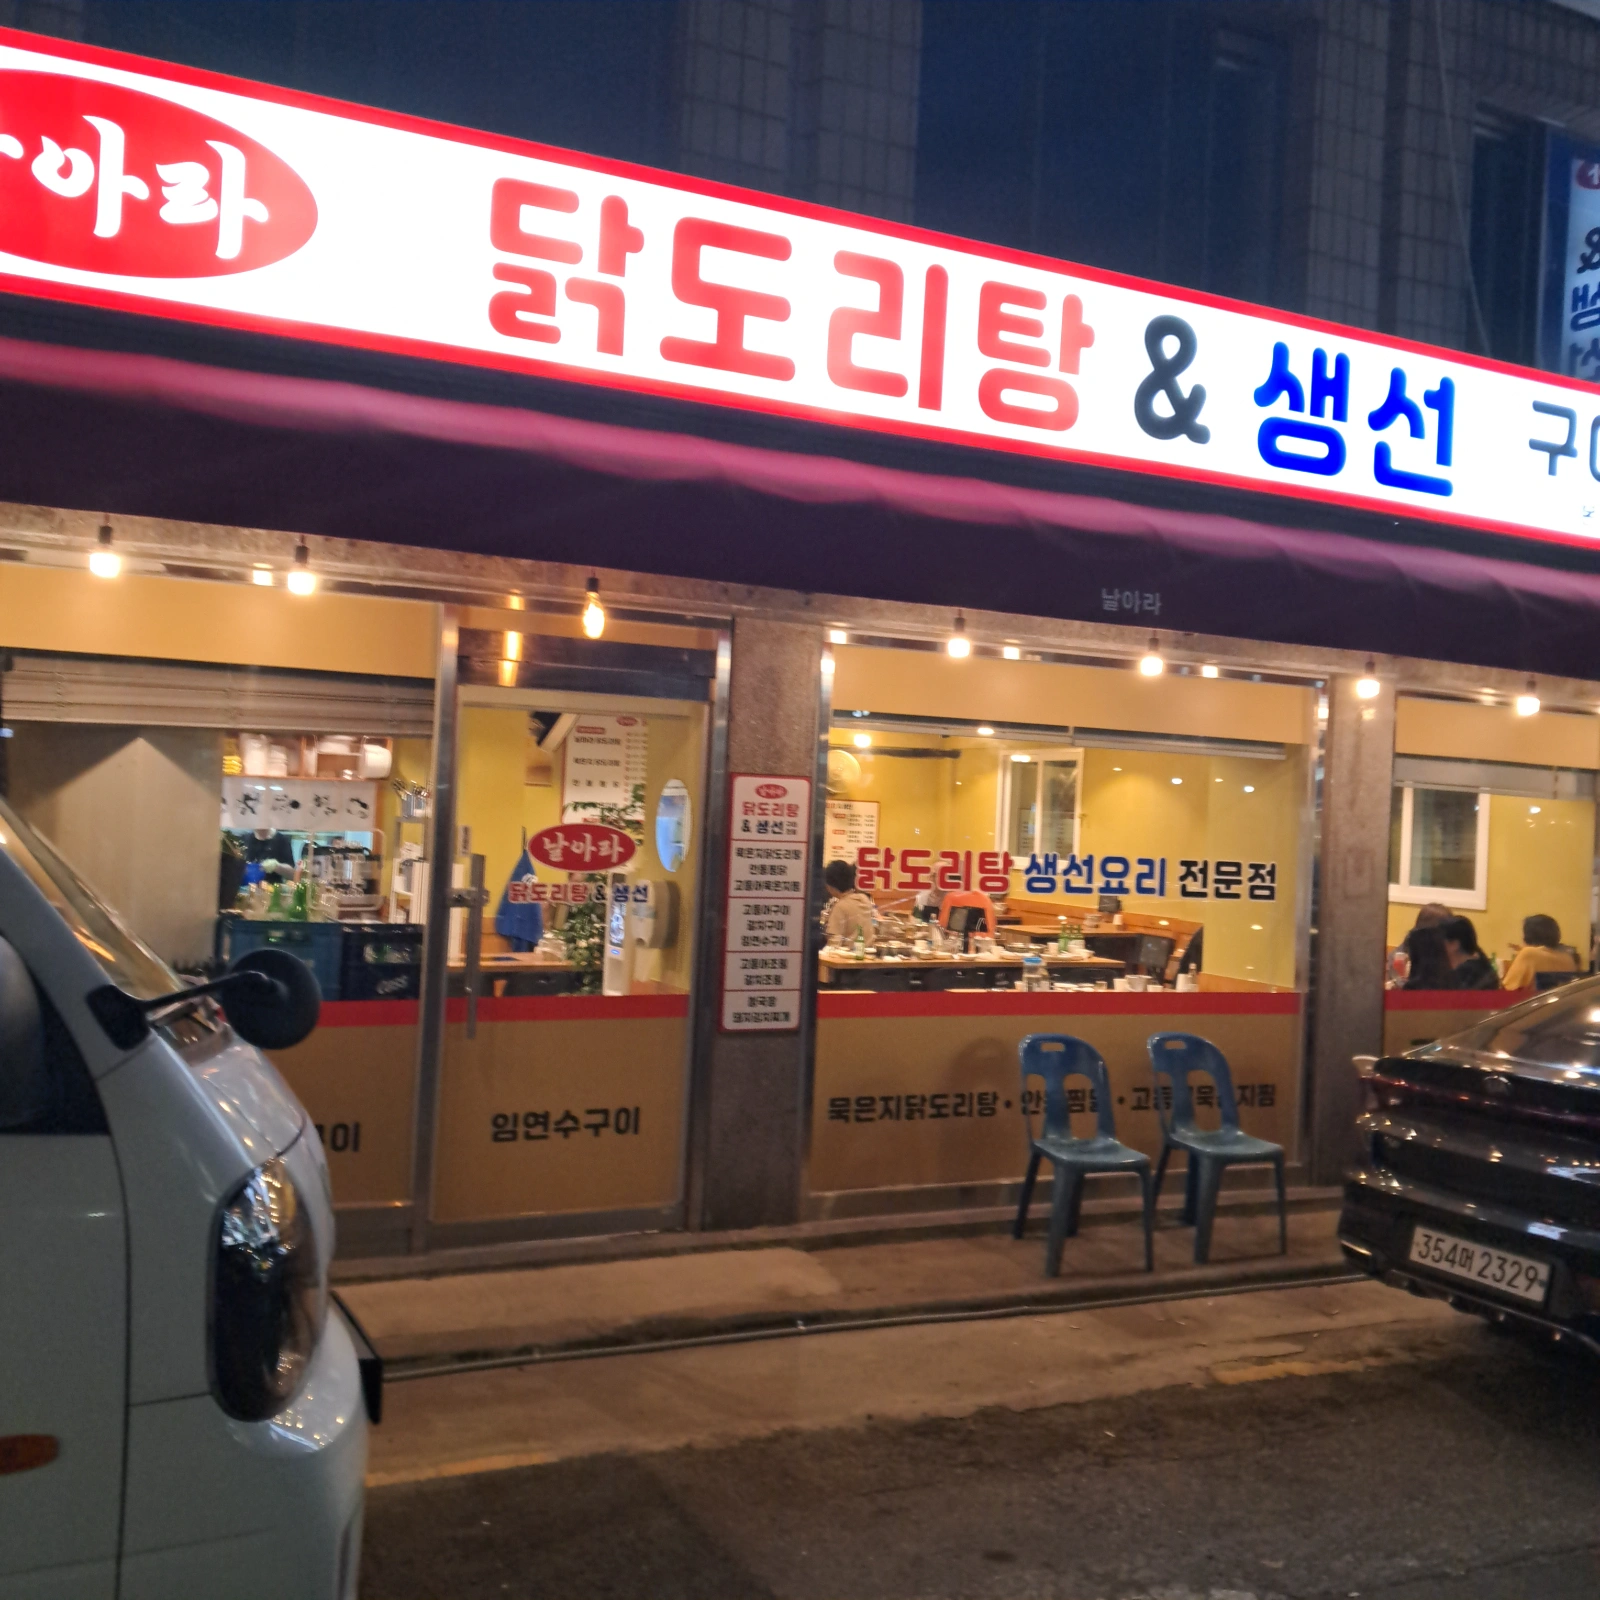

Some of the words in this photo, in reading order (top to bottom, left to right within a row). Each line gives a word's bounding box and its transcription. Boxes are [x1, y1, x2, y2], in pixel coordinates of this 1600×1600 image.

[0, 114, 270, 261] 아라
[487, 176, 1096, 432] 닭도리탕
[1134, 314, 1212, 444] &
[1253, 341, 1456, 497] 생선
[1100, 587, 1163, 616] 날아라
[742, 801, 800, 818] 닭도리탕
[756, 819, 784, 835] 생선
[541, 831, 625, 864] 날아라
[855, 846, 1015, 894] 닭도리탕
[1023, 853, 1168, 897] 생선요리
[1178, 858, 1278, 901] 전문점
[508, 881, 589, 904] 닭도리탕
[613, 884, 648, 904] 생선
[828, 1091, 999, 1123] 묵은지닭도리탕
[315, 1121, 361, 1153] 이
[491, 1106, 641, 1143] 임연수구이
